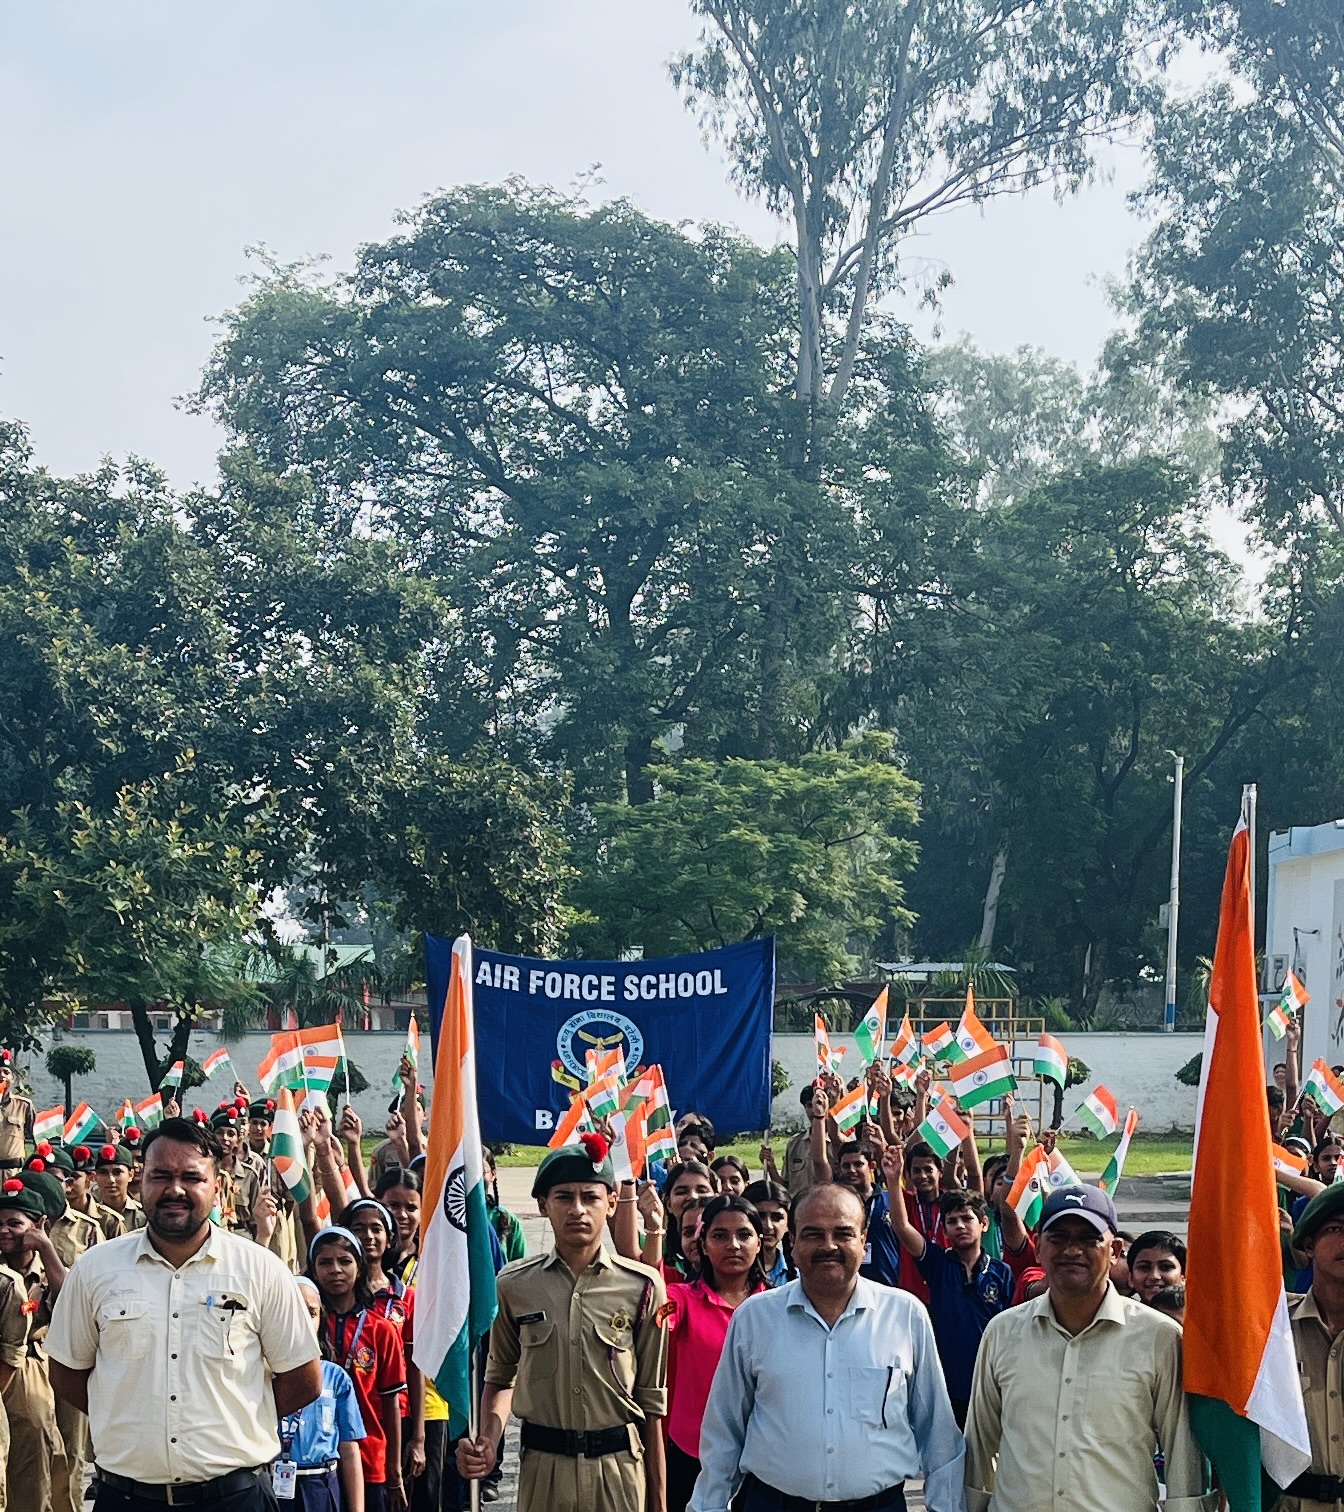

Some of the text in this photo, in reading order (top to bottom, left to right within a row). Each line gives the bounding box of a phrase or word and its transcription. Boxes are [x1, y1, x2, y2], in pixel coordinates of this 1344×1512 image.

[475, 960, 728, 1001] AIR FORCE SCHOOL
